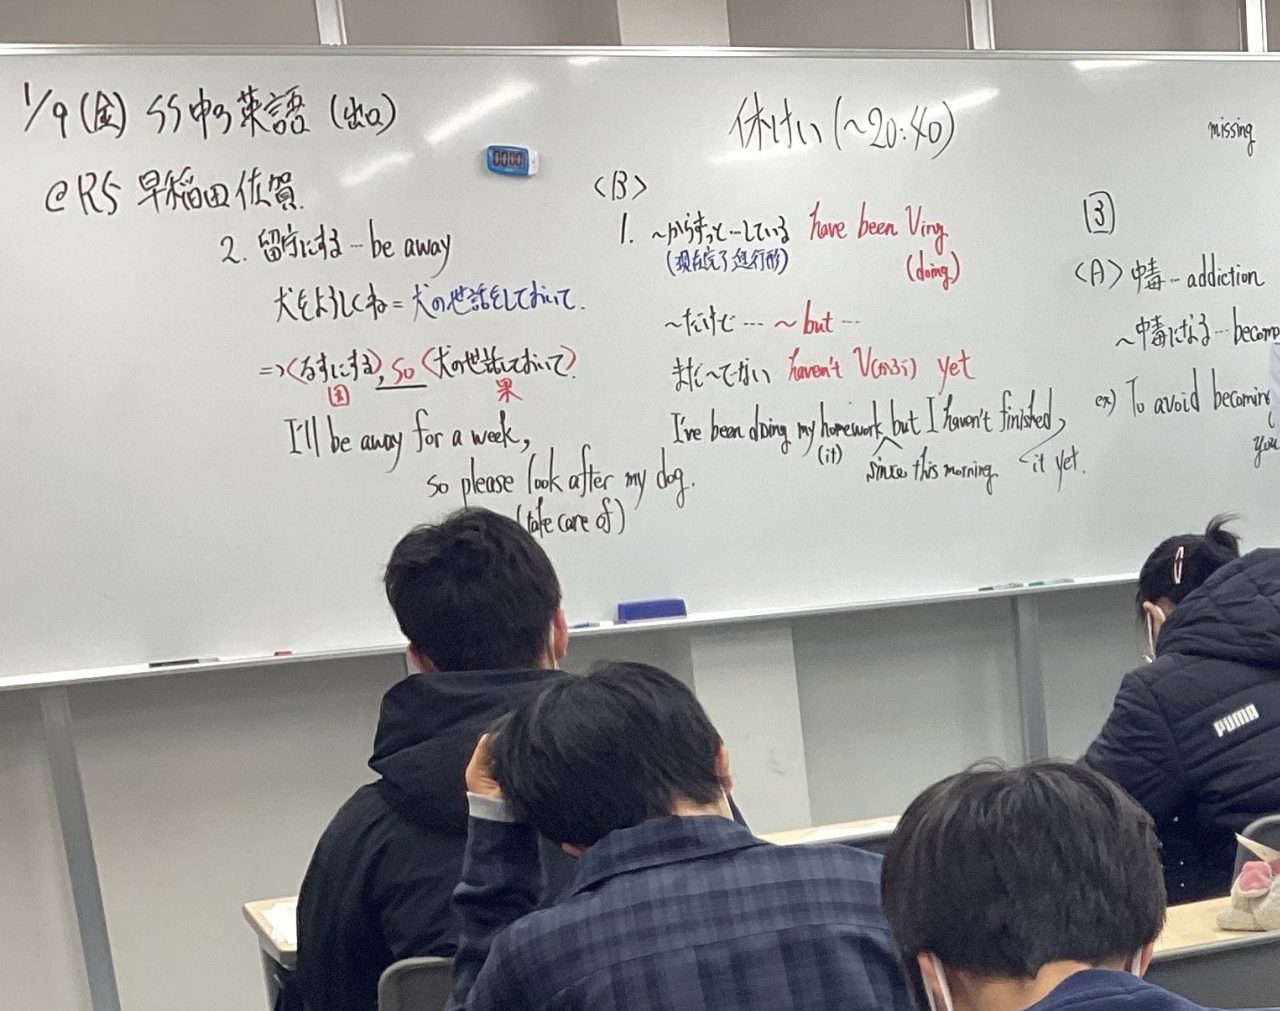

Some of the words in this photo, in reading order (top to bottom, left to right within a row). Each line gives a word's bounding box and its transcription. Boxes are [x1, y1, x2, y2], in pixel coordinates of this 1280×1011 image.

[1208, 116, 1256, 157] missing
[809, 200, 849, 242] have
[857, 200, 899, 240] been
[220, 235, 247, 264] 2.
[369, 218, 395, 260] be
[403, 233, 452, 280] away
[905, 249, 961, 290] (doing)
[1186, 251, 1266, 289] addiction
[787, 346, 844, 382] haven't
[936, 348, 977, 396] yet
[1125, 375, 1145, 418] To
[1153, 366, 1200, 414] avoid
[328, 414, 353, 455] be
[360, 429, 403, 474] away
[414, 407, 444, 454] for
[452, 429, 464, 447] a
[670, 411, 703, 444] I've
[710, 407, 746, 443] been
[796, 420, 816, 458] my
[820, 400, 885, 440] homework
[890, 398, 922, 437] but
[926, 396, 940, 434] I
[942, 393, 994, 433] haven't
[817, 443, 843, 466] (it)
[912, 445, 940, 482] this
[943, 460, 999, 496] morning
[1252, 434, 1280, 469] you
[460, 456, 515, 510] please
[527, 446, 565, 495] look
[568, 443, 615, 498] after
[624, 468, 647, 510] my
[556, 512, 590, 533] care
[595, 497, 626, 536] of)
[1213, 704, 1260, 738] PUMA
